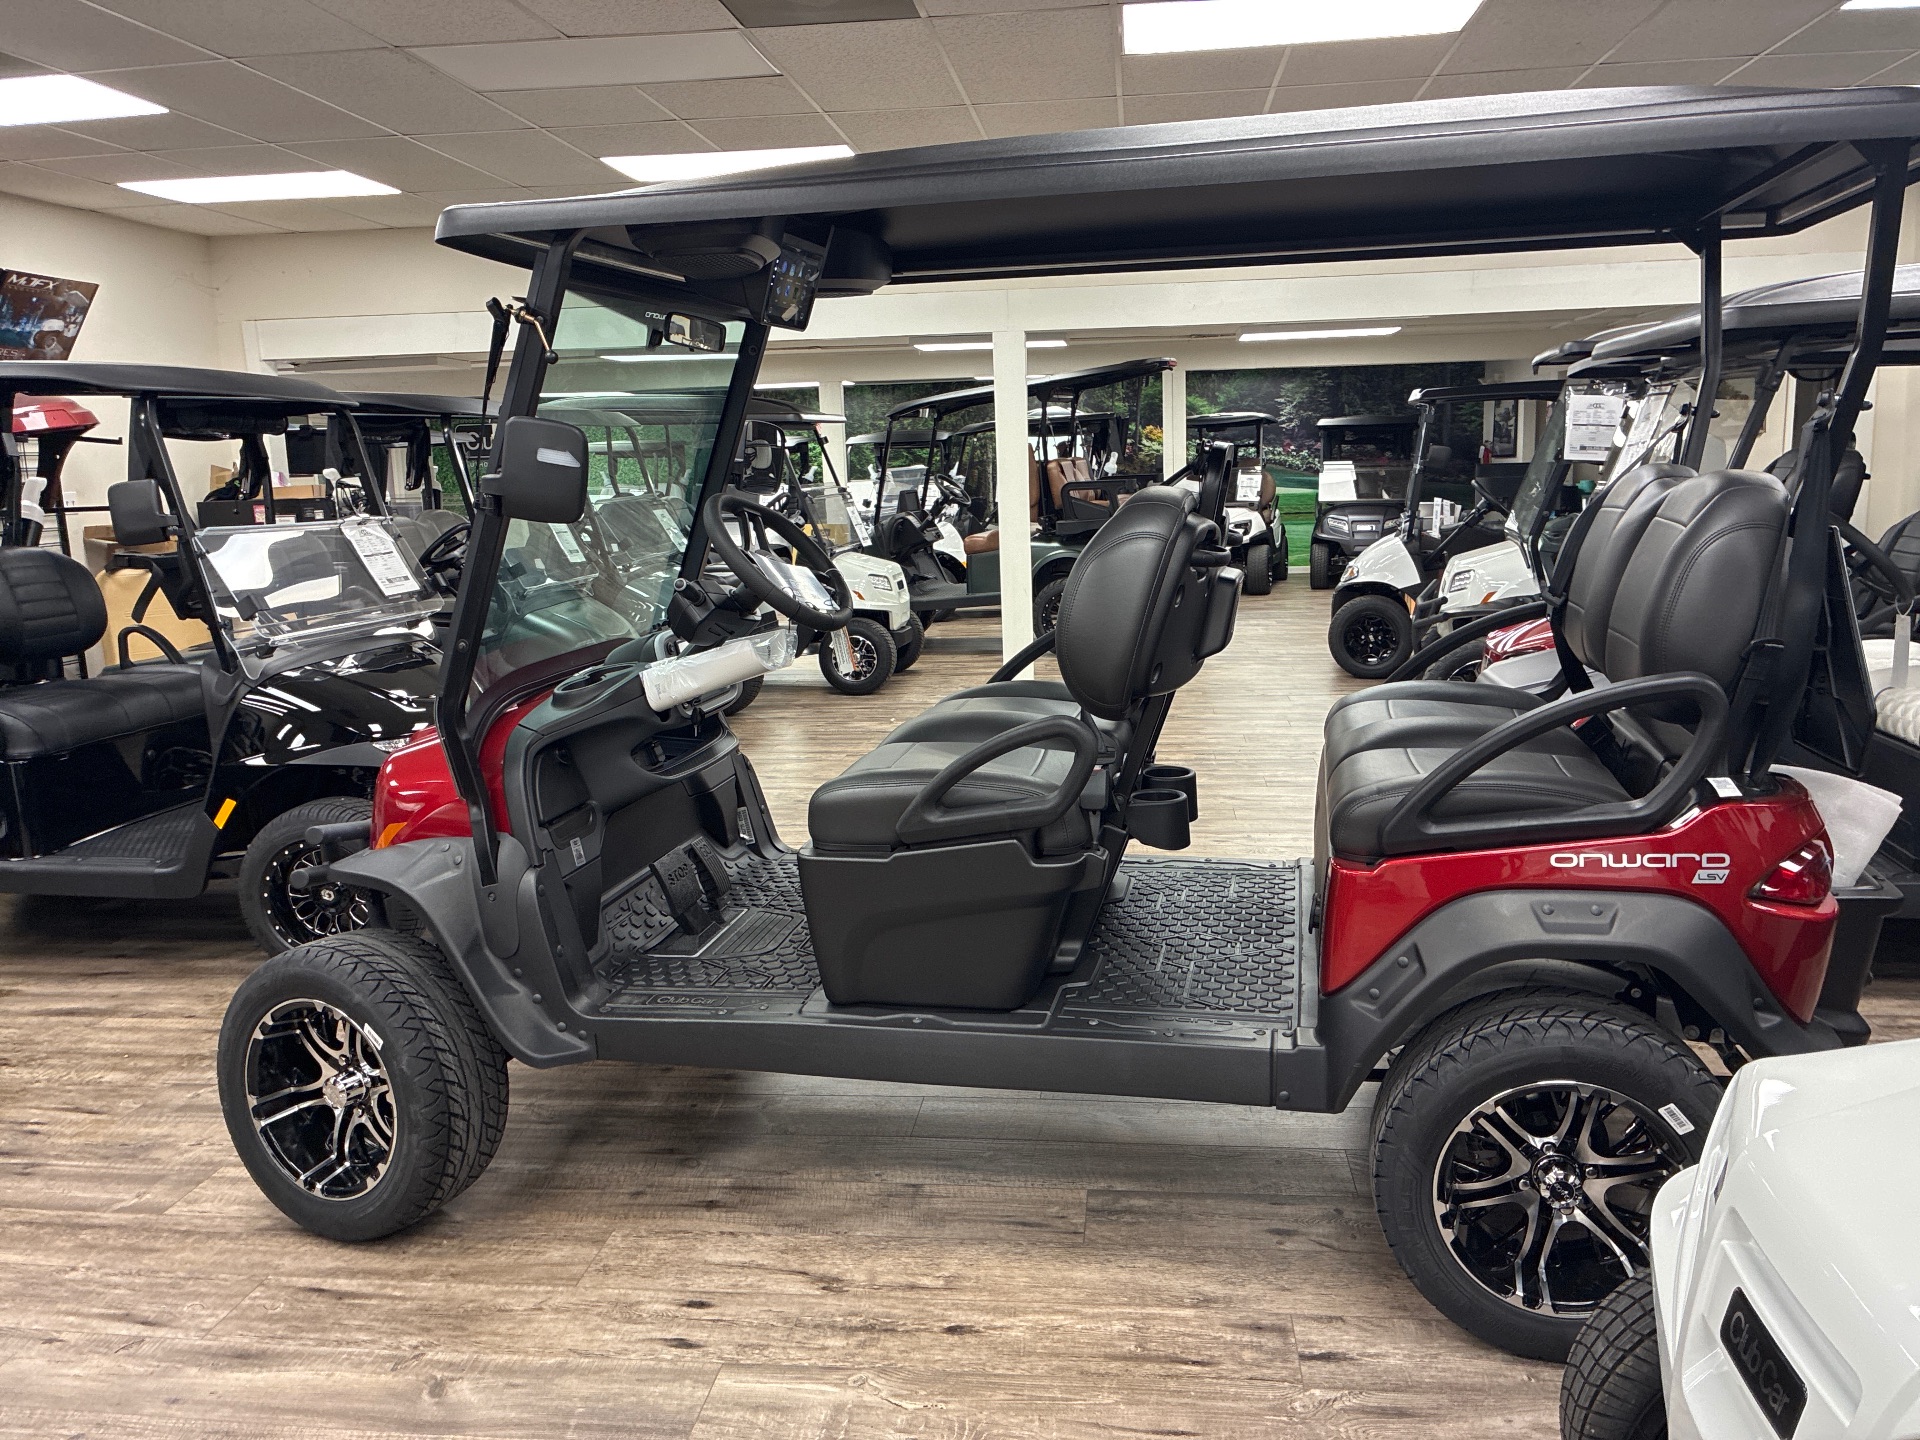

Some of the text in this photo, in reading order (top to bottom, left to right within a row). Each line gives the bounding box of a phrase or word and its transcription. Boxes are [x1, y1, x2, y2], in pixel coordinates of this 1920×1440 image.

[667, 862, 690, 886] STOP
[1697, 873, 1727, 881] LSV
[656, 995, 715, 1005] Club Car
[1729, 1311, 1791, 1416] Club Car
